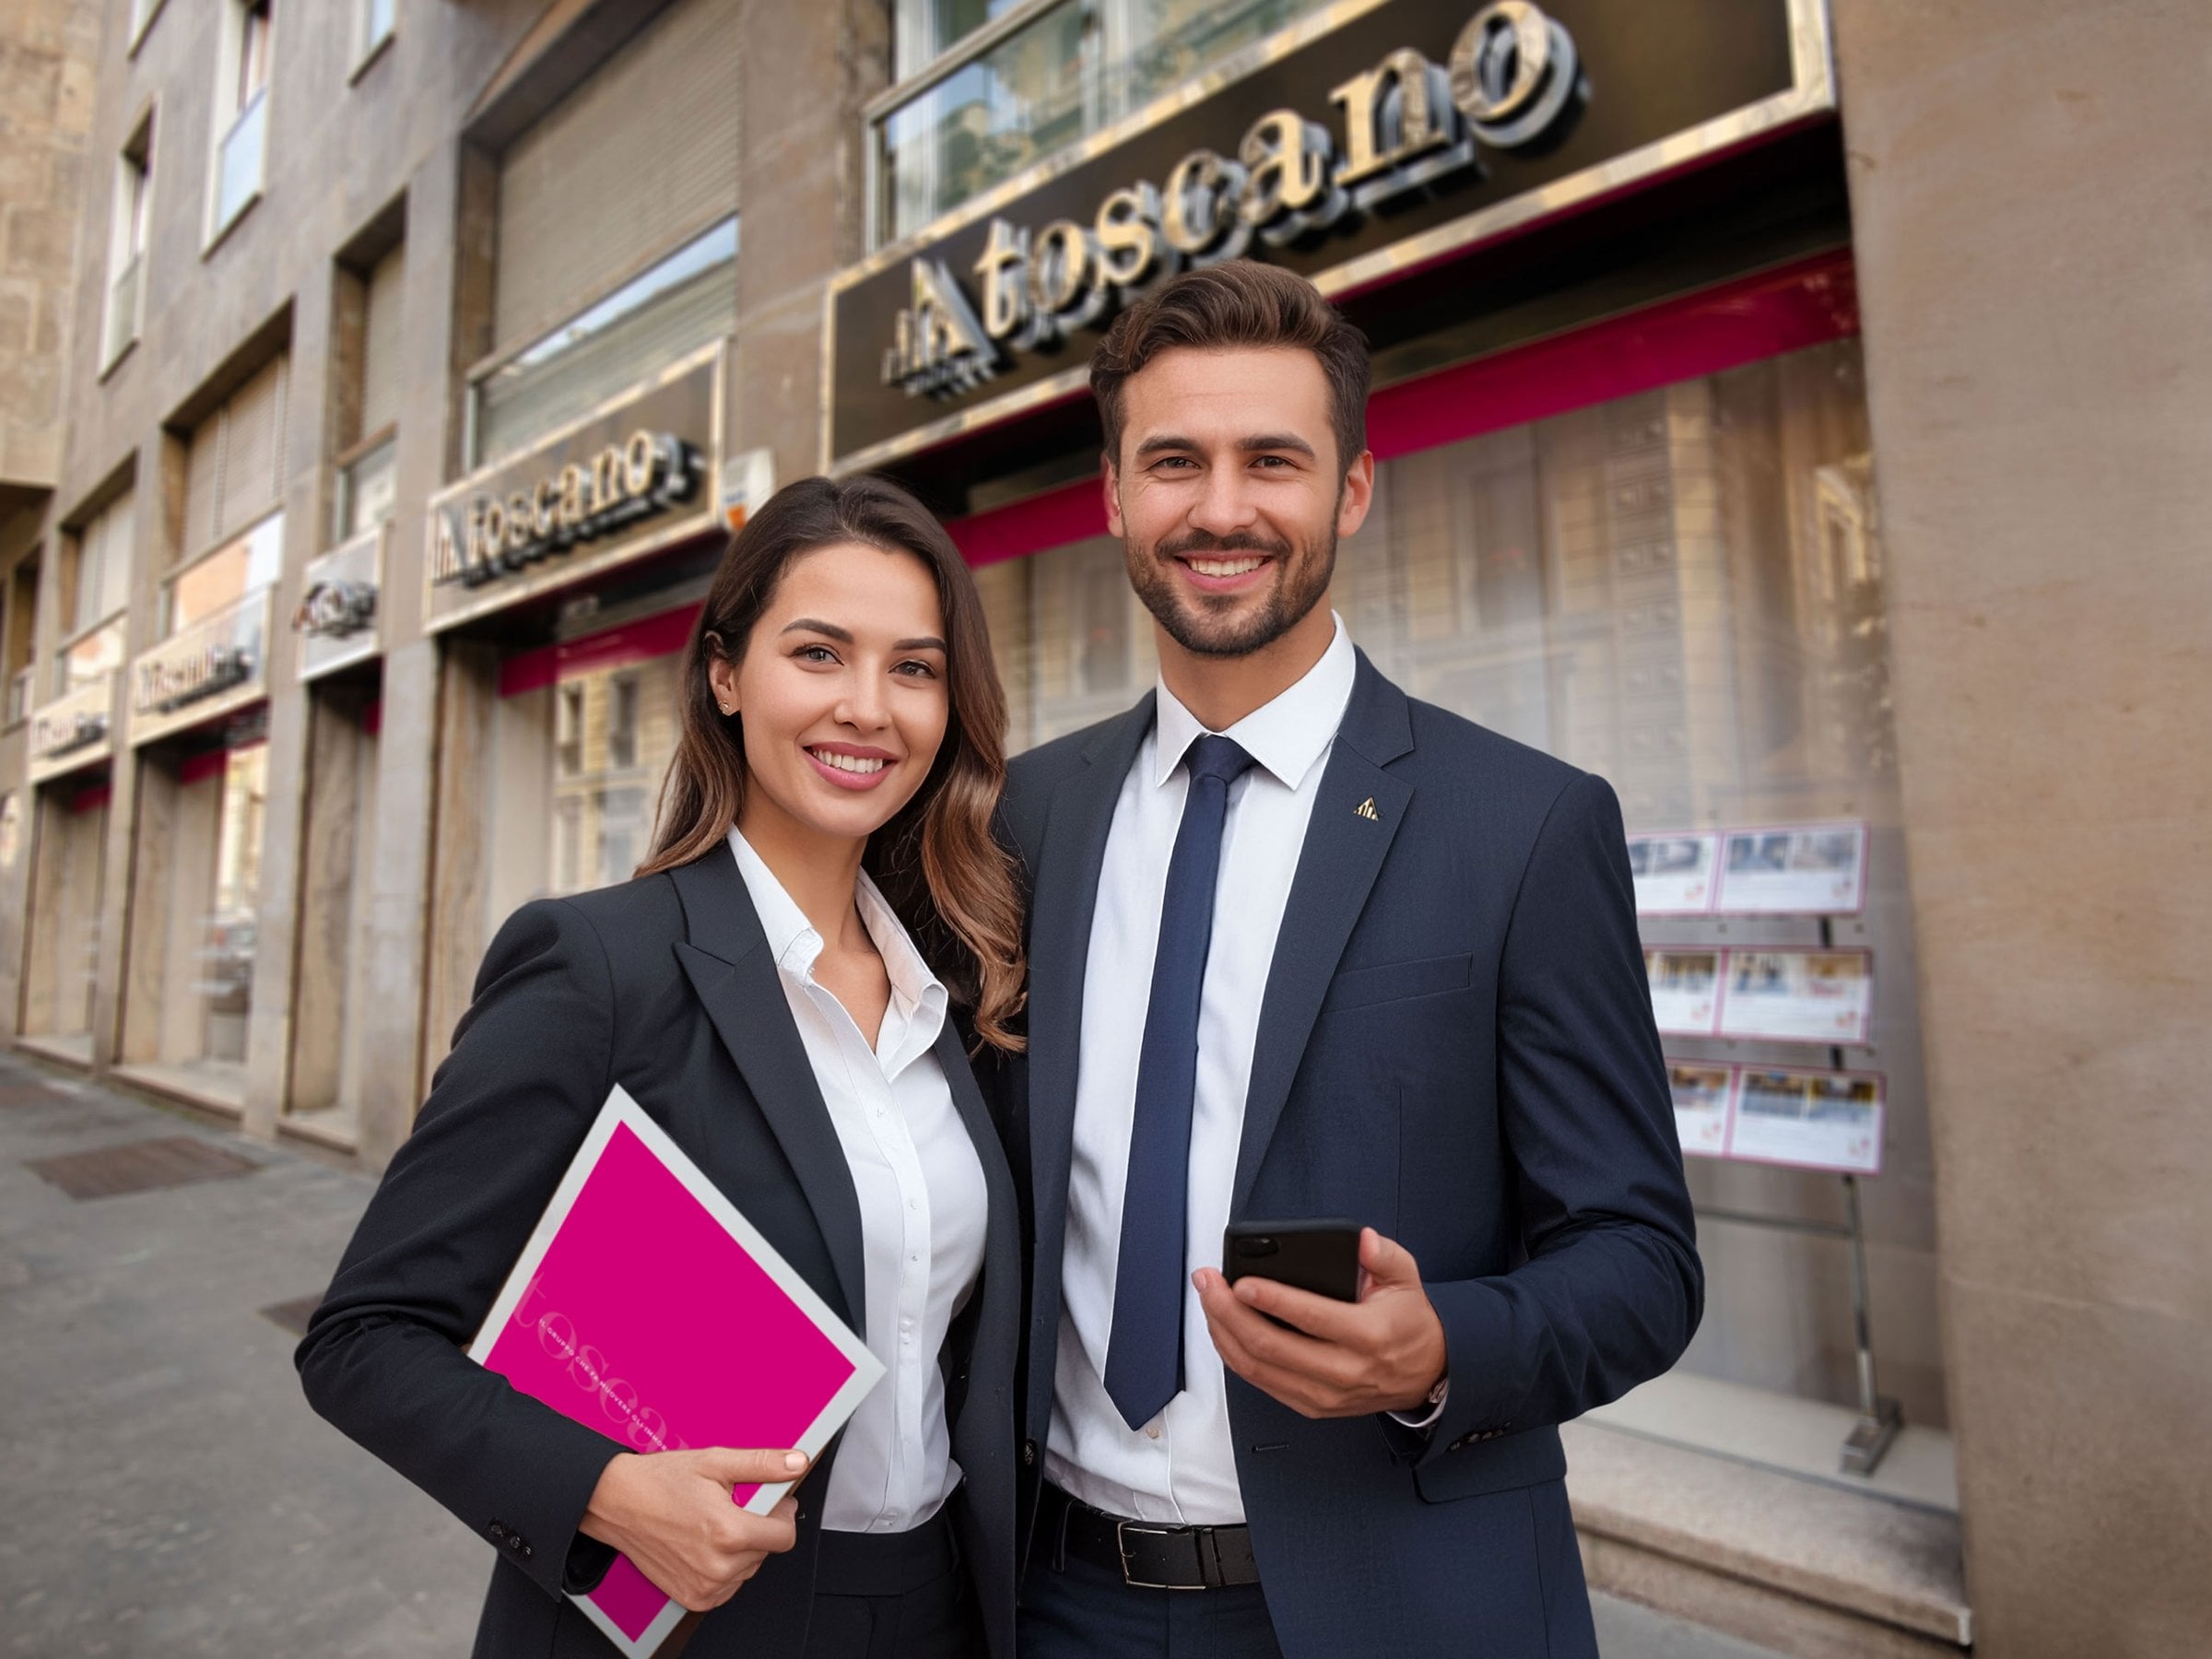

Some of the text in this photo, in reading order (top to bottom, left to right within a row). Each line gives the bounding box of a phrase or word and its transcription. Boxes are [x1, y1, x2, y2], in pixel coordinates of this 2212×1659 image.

[513, 1271, 689, 1453] tosca
[547, 1327, 575, 1357] GRUPPO
[575, 1356, 591, 1372] CHE
[599, 1381, 631, 1415] MUOVERE
